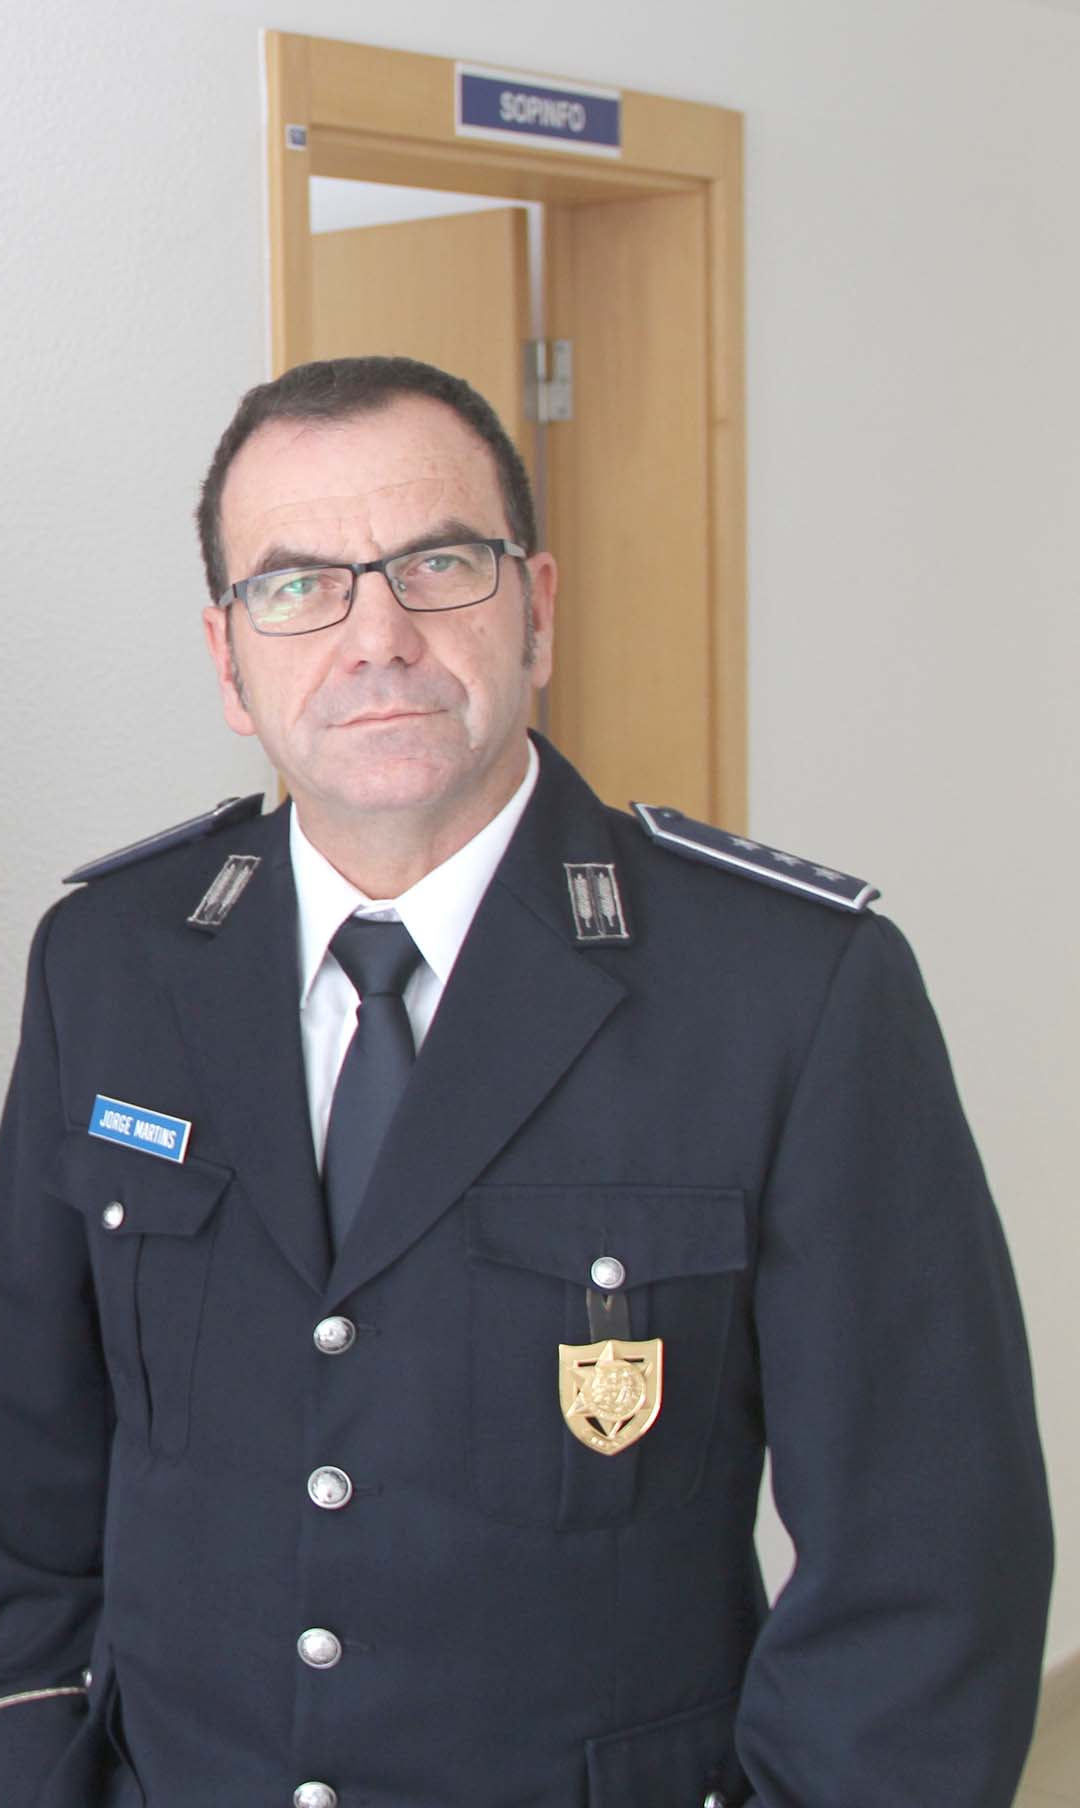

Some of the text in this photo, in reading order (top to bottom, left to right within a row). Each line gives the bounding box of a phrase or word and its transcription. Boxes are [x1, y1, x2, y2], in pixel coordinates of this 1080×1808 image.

[499, 91, 587, 133] SOPINFO
[99, 1109, 177, 1149] JORGE MARTINS
